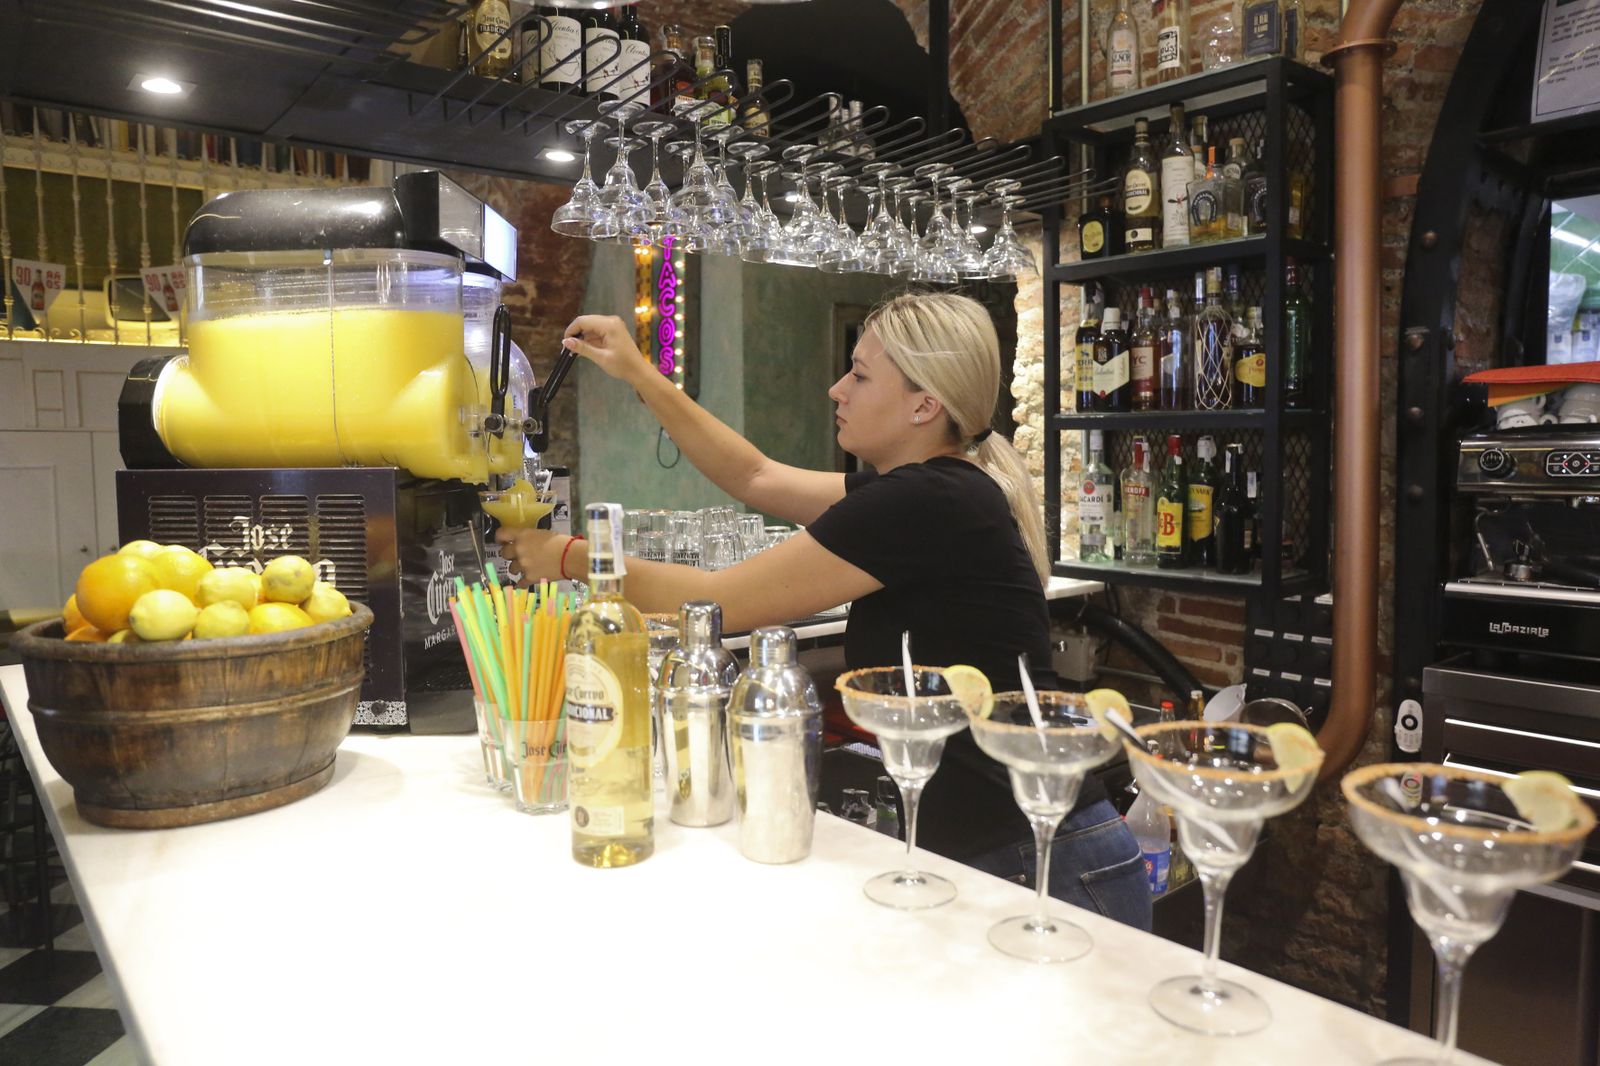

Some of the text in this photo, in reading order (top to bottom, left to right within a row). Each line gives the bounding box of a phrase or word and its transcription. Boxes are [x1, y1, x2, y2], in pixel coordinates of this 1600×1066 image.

[16, 266, 32, 286] 90
[145, 273, 161, 292] 90
[658, 235, 677, 375] TACOS
[1133, 355, 1147, 365] YC
[427, 571, 459, 625] Cuer
